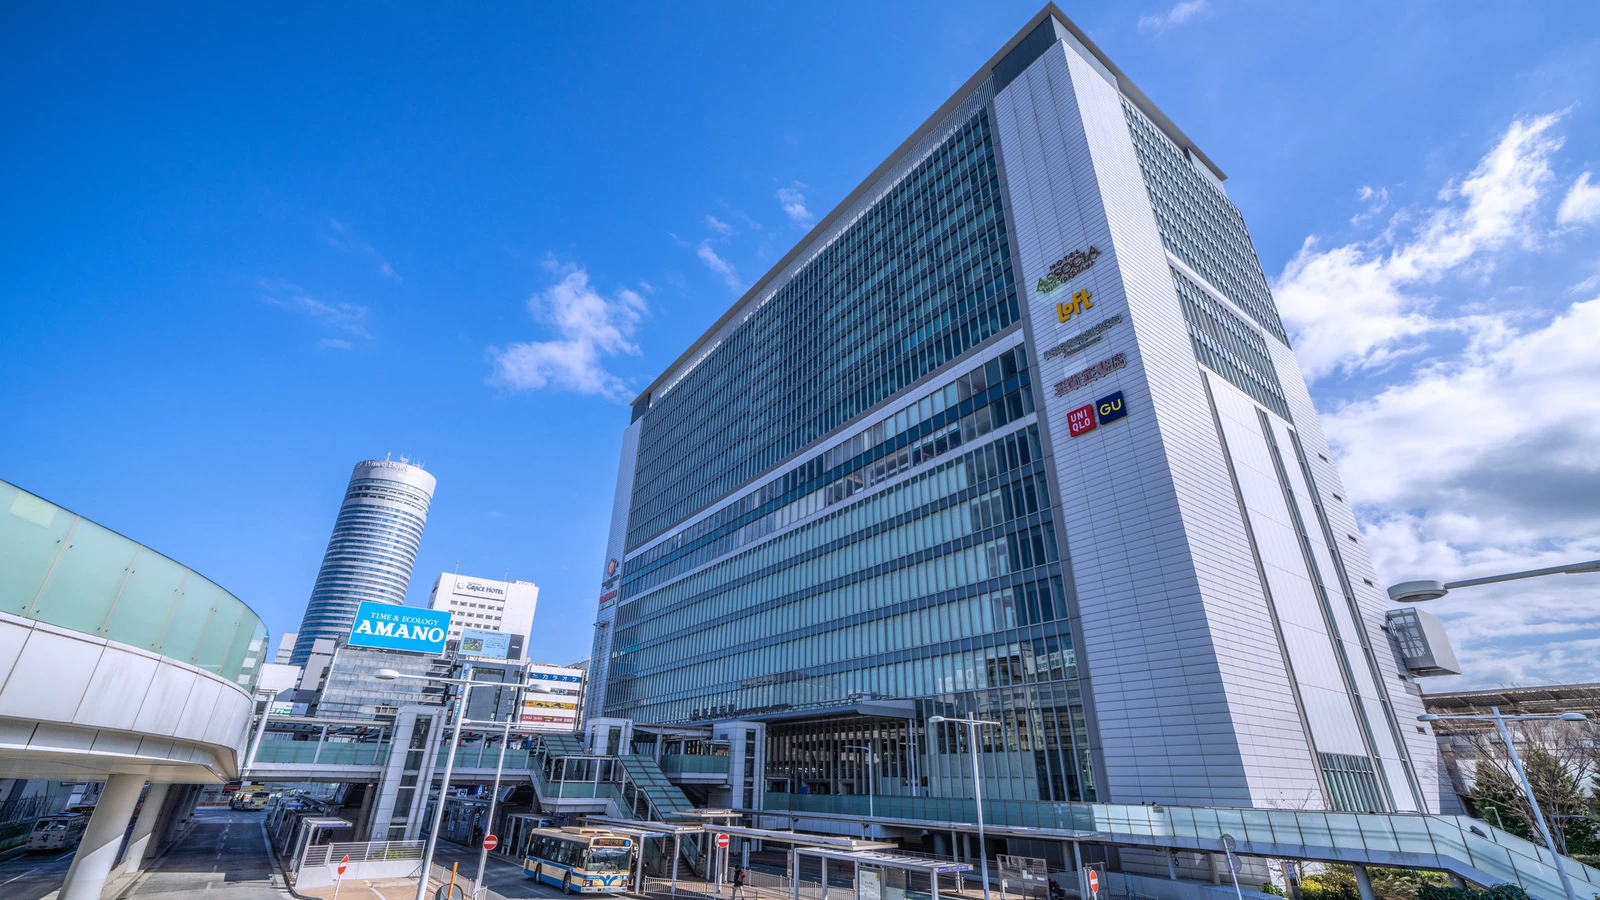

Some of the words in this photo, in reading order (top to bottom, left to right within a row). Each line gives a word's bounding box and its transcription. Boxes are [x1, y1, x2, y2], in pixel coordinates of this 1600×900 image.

[1049, 249, 1080, 270] HOTEL
[1035, 245, 1101, 292] ASSOCIA
[1099, 398, 1122, 416] GU
[1070, 409, 1088, 423] UNI
[1072, 418, 1091, 432] QLO
[466, 583, 485, 592] GRACE
[486, 586, 504, 595] HOTEL
[371, 612, 392, 620] TIME
[402, 616, 440, 626] ECOLOGY
[354, 620, 445, 643] AMANO
[542, 674, 578, 682] カラオケ
